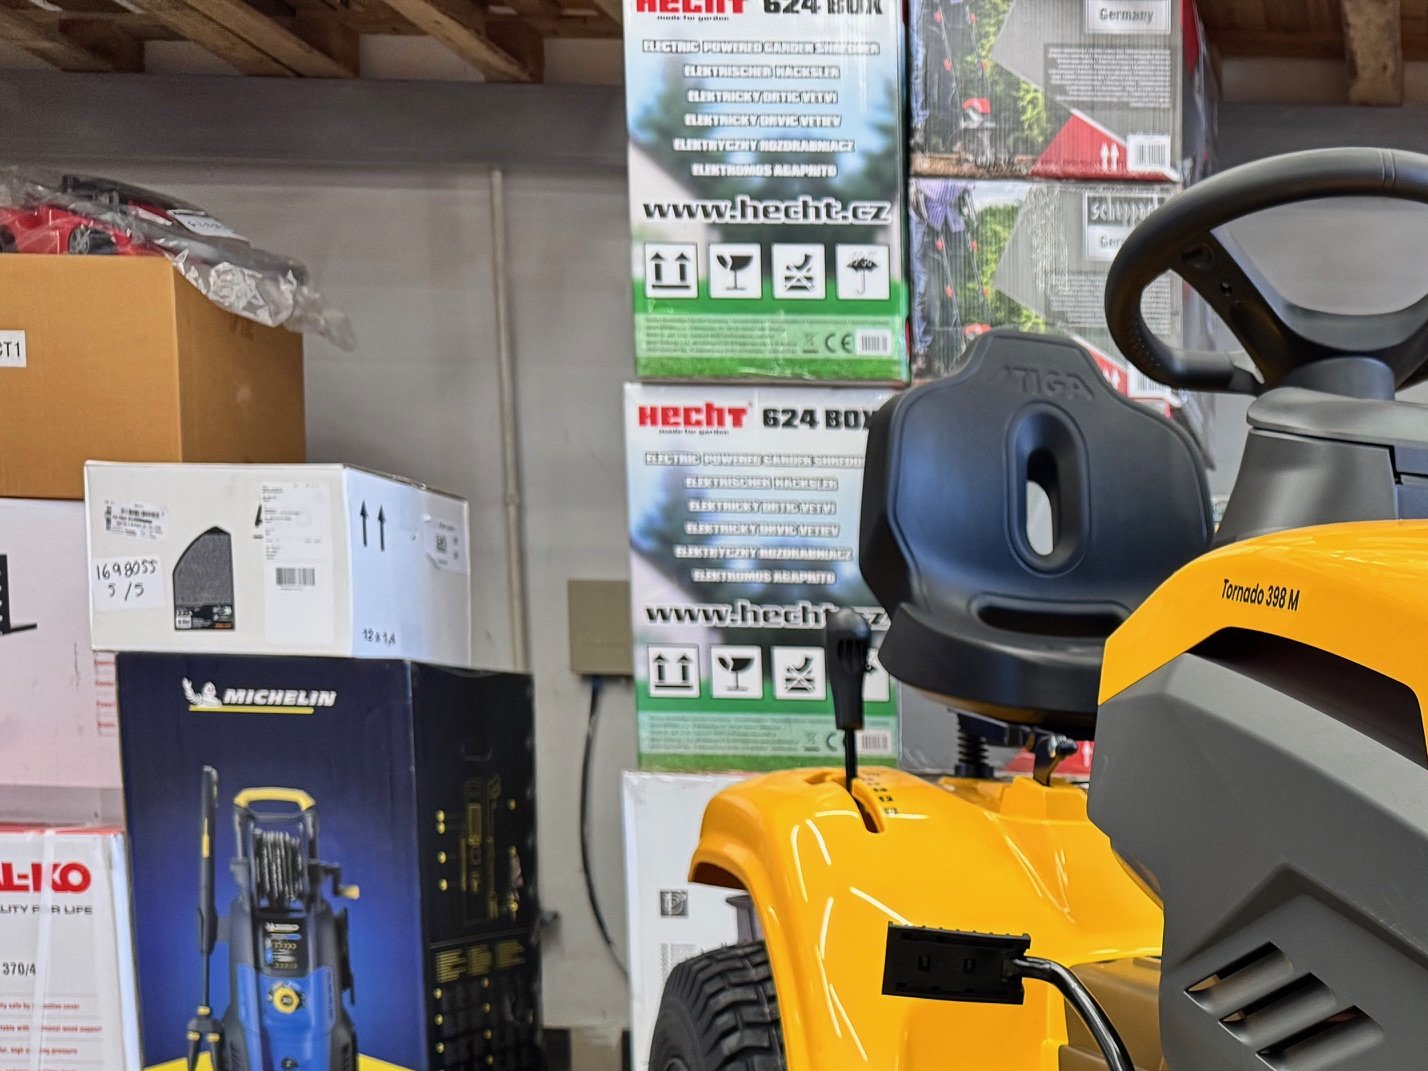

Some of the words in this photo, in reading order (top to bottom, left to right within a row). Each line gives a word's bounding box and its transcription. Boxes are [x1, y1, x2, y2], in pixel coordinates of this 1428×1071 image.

[763, 0, 820, 14] 624
[1100, 7, 1154, 25] Germany
[643, 40, 700, 53] ELECTRIC
[702, 41, 762, 54] POWERED
[642, 196, 892, 223] www.hecht.cz
[762, 408, 818, 430] 624
[646, 453, 700, 466] ELECTRIC
[703, 454, 761, 466] POWERED
[96, 559, 158, 582] 1698055
[1222, 579, 1264, 605] Tornado
[1266, 585, 1287, 609] 398
[1287, 589, 1300, 611] M
[223, 688, 337, 706] MICHELIN
[0, 862, 91, 893] L-KO
[3, 962, 36, 976] 370/4
